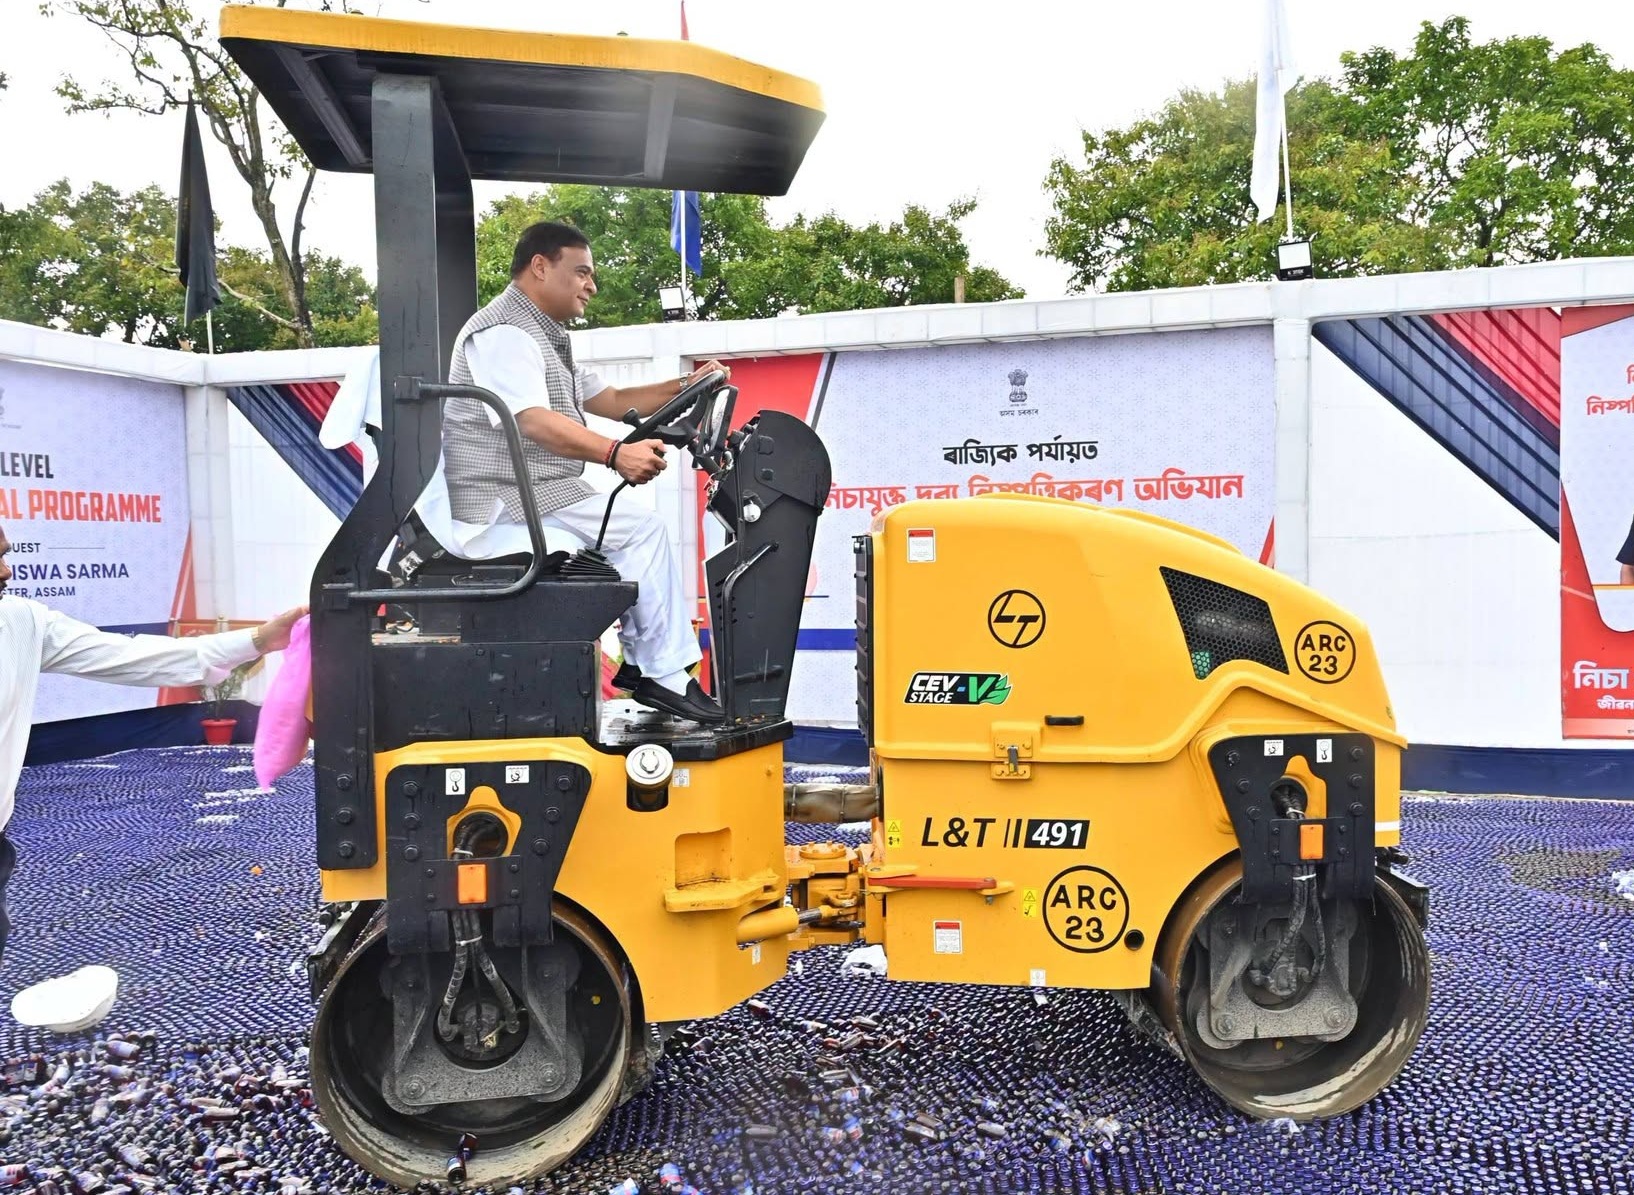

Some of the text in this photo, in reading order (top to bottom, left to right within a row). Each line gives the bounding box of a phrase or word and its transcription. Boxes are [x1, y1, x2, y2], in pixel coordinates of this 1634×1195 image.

[0, 451, 54, 479] LEVEL
[942, 438, 1018, 467] ৰাজ্যিক
[1133, 466, 1244, 502] অভিযান
[28, 489, 162, 523] PROGRAMME
[11, 542, 41, 553] UEST
[12, 563, 130, 581] ISWA SARMA
[35, 586, 76, 598] ASSAM
[1301, 633, 1346, 652] ARC
[1309, 654, 1338, 676] 23
[1573, 660, 1629, 690] নিচা
[912, 675, 960, 692] CEV
[909, 692, 954, 703] STAGE
[921, 817, 1083, 848] L&T 491
[1050, 884, 1117, 911] ARC
[1065, 915, 1105, 943] 23
